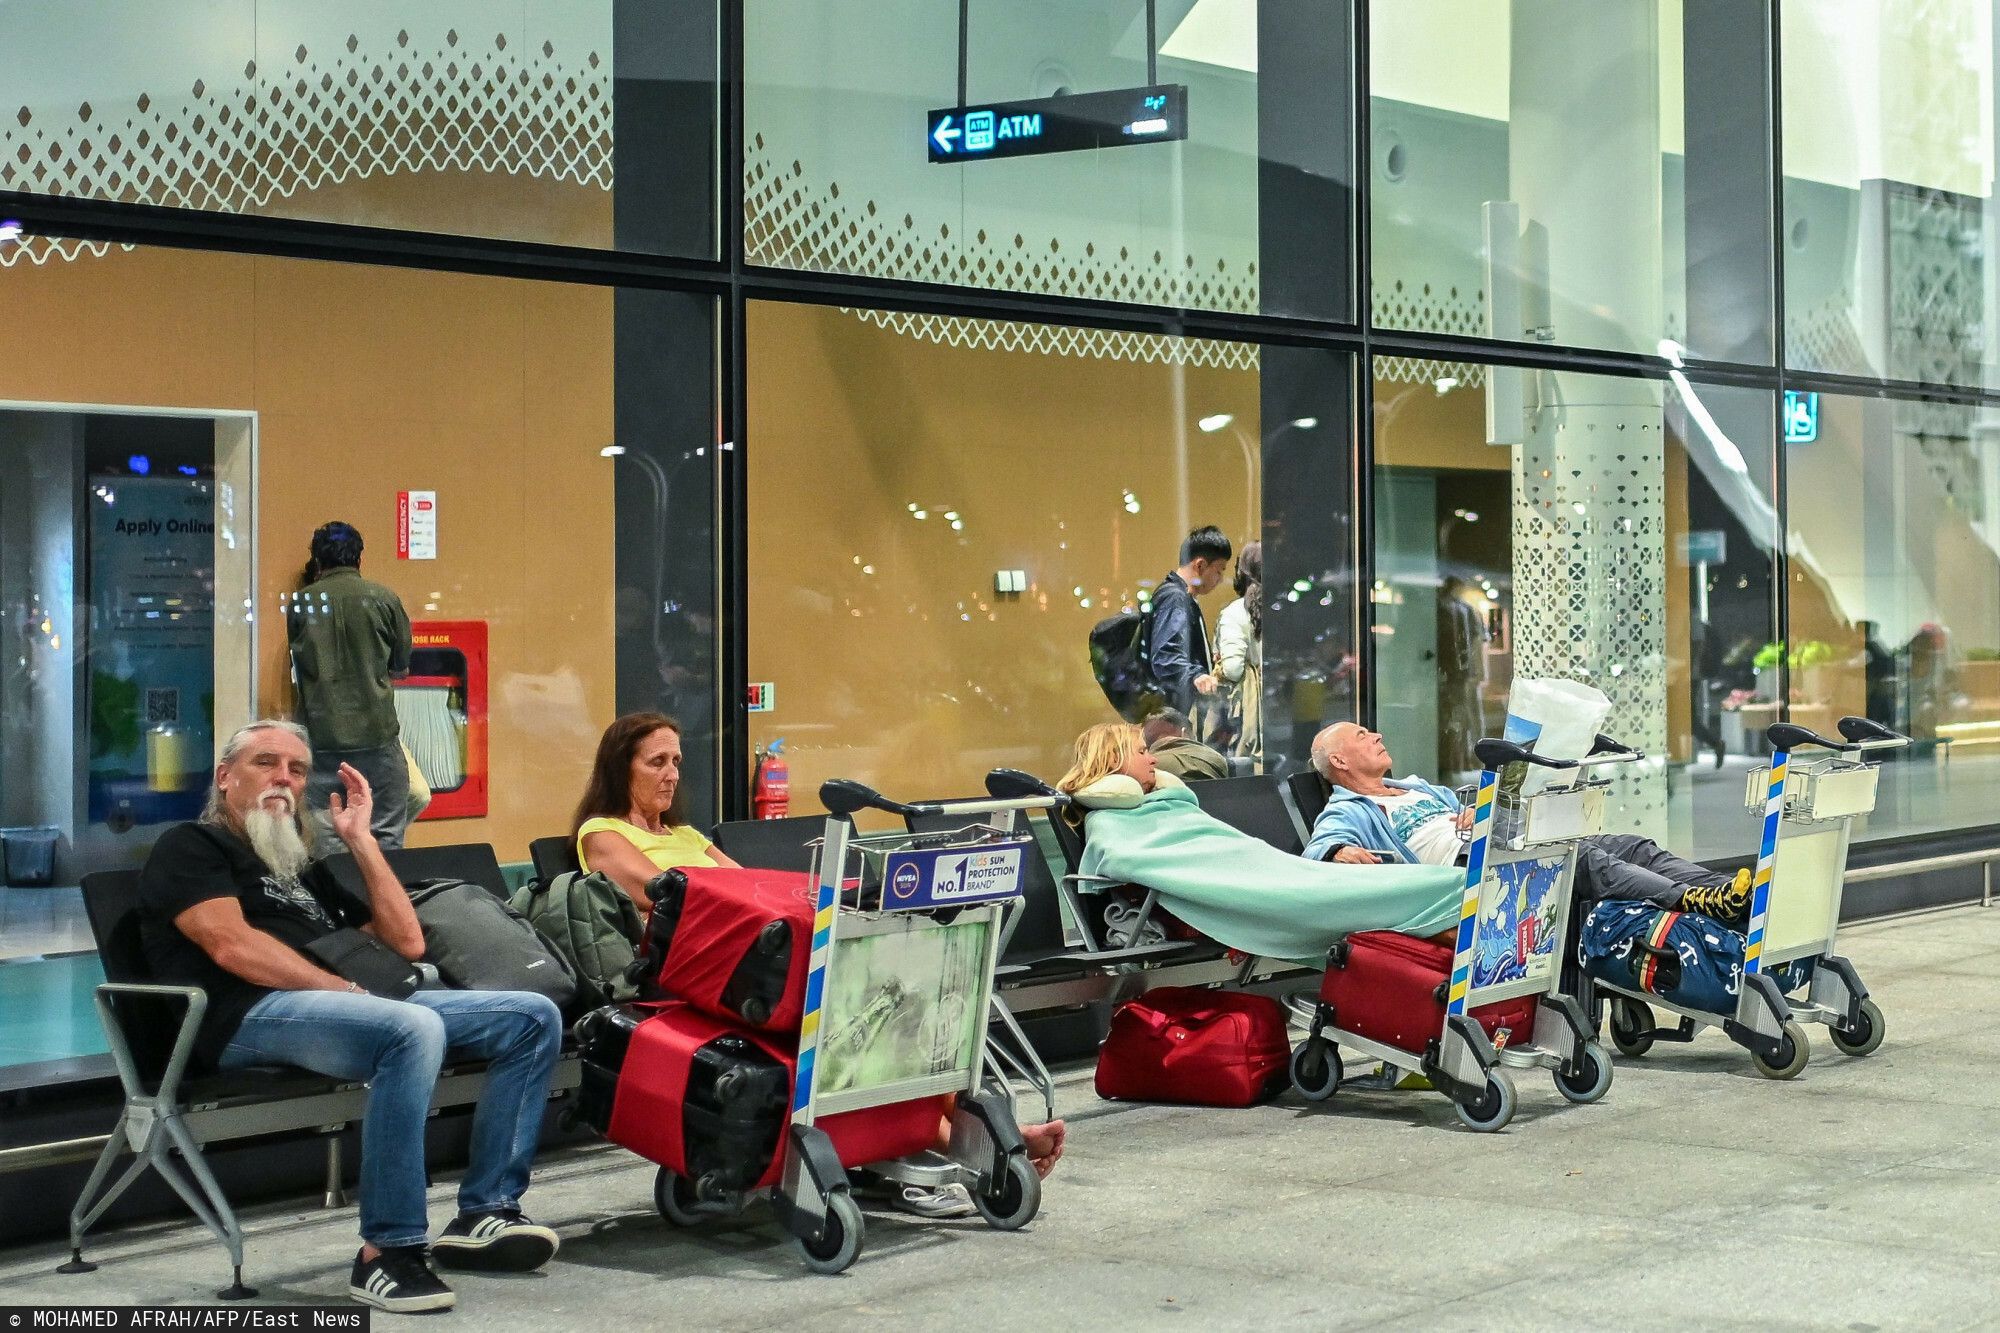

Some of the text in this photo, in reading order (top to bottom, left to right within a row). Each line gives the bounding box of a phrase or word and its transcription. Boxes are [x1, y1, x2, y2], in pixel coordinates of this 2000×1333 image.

[971, 119, 989, 131] ATM
[998, 114, 1040, 139] ATM
[115, 517, 161, 536] Apply
[430, 634, 450, 644] RACK
[990, 856, 1005, 865] SUN
[968, 865, 1015, 879] PROTECTION
[897, 874, 916, 883] NIVEA
